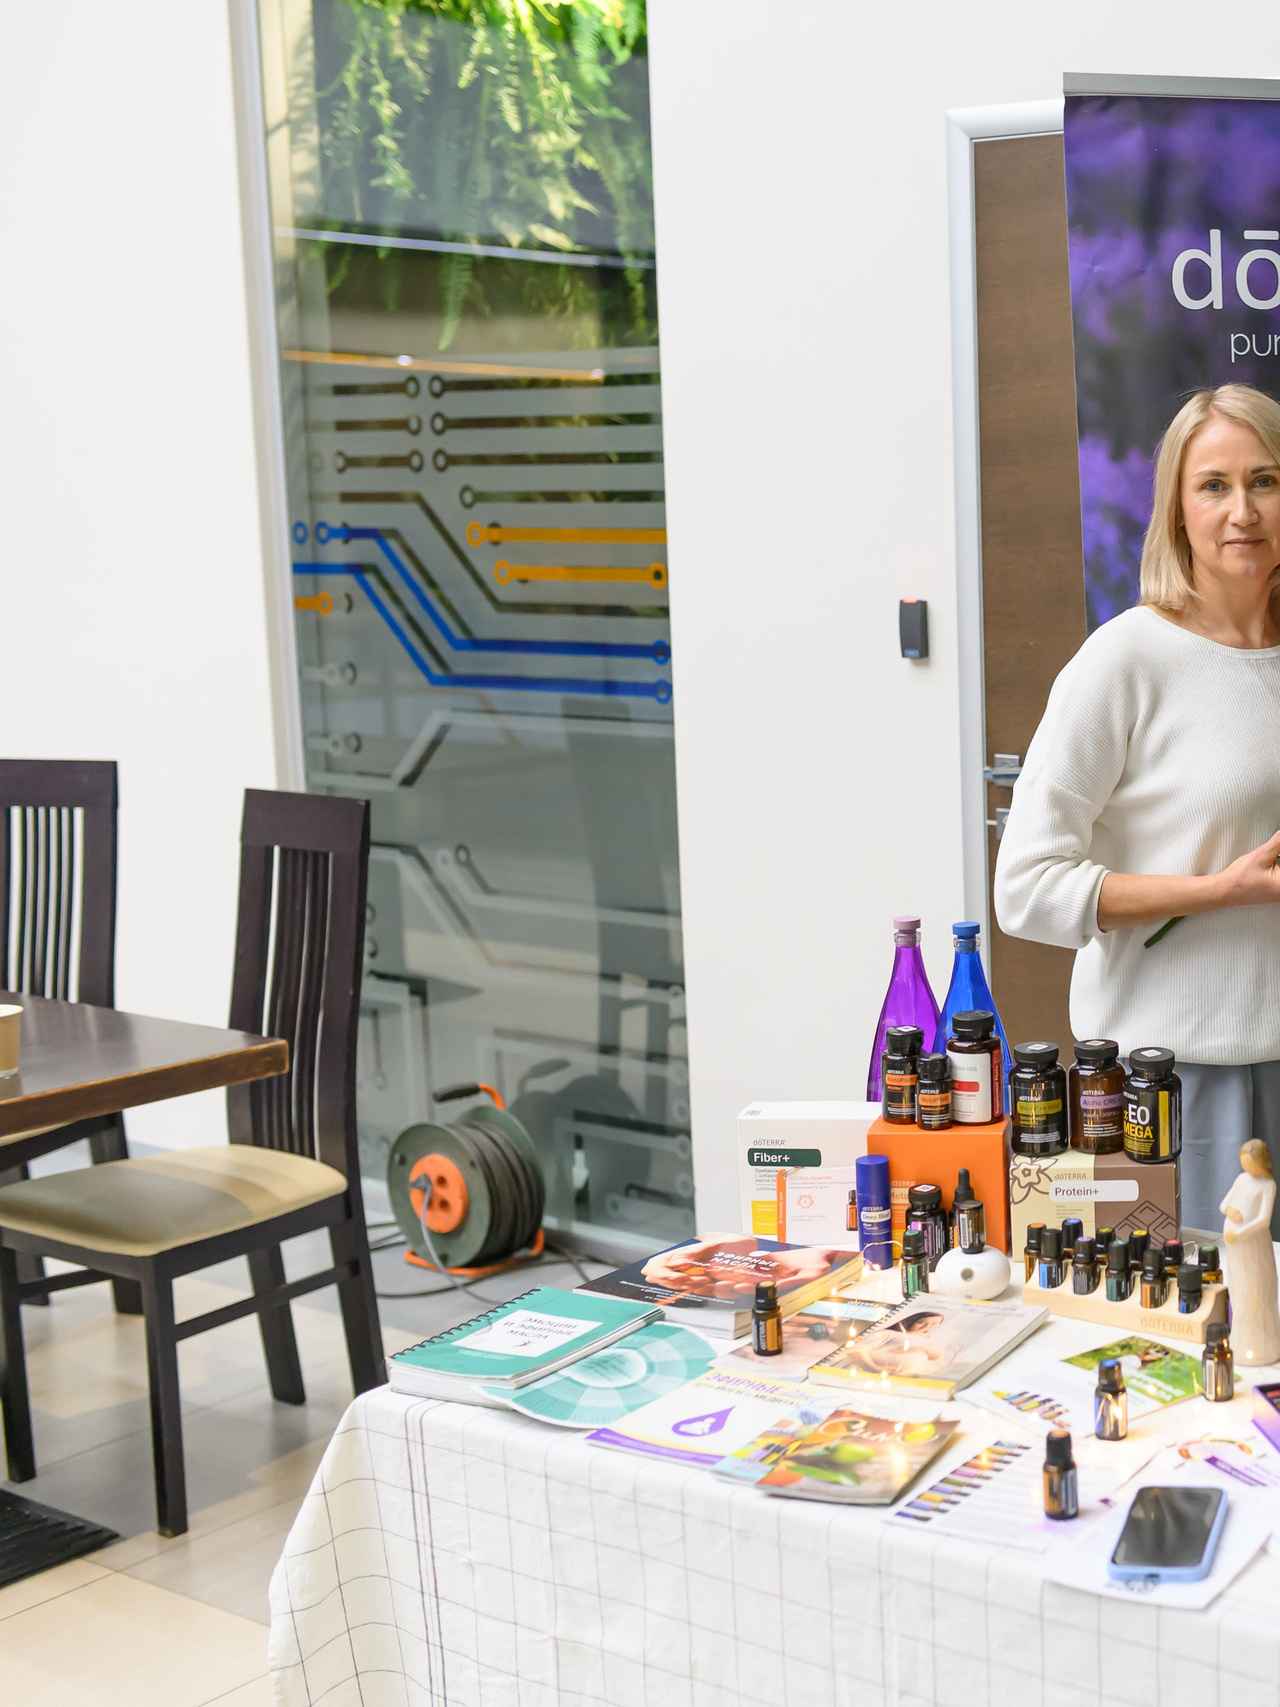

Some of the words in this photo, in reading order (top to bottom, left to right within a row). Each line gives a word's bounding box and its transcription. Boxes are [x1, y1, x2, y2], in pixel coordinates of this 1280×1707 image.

[753, 1152, 790, 1163] Fiber+
[1054, 1186, 1100, 1197] Protein+
[710, 1257, 757, 1270] МАСЛА
[713, 1251, 780, 1268] ЭФИРНЫЕ
[526, 1317, 578, 1329] ЭМОЦИИ
[506, 1329, 549, 1340] МАСЛА
[515, 1323, 575, 1336] ЭФИРНЫЕ
[706, 1372, 785, 1394] ЭФИРНЫЕ
